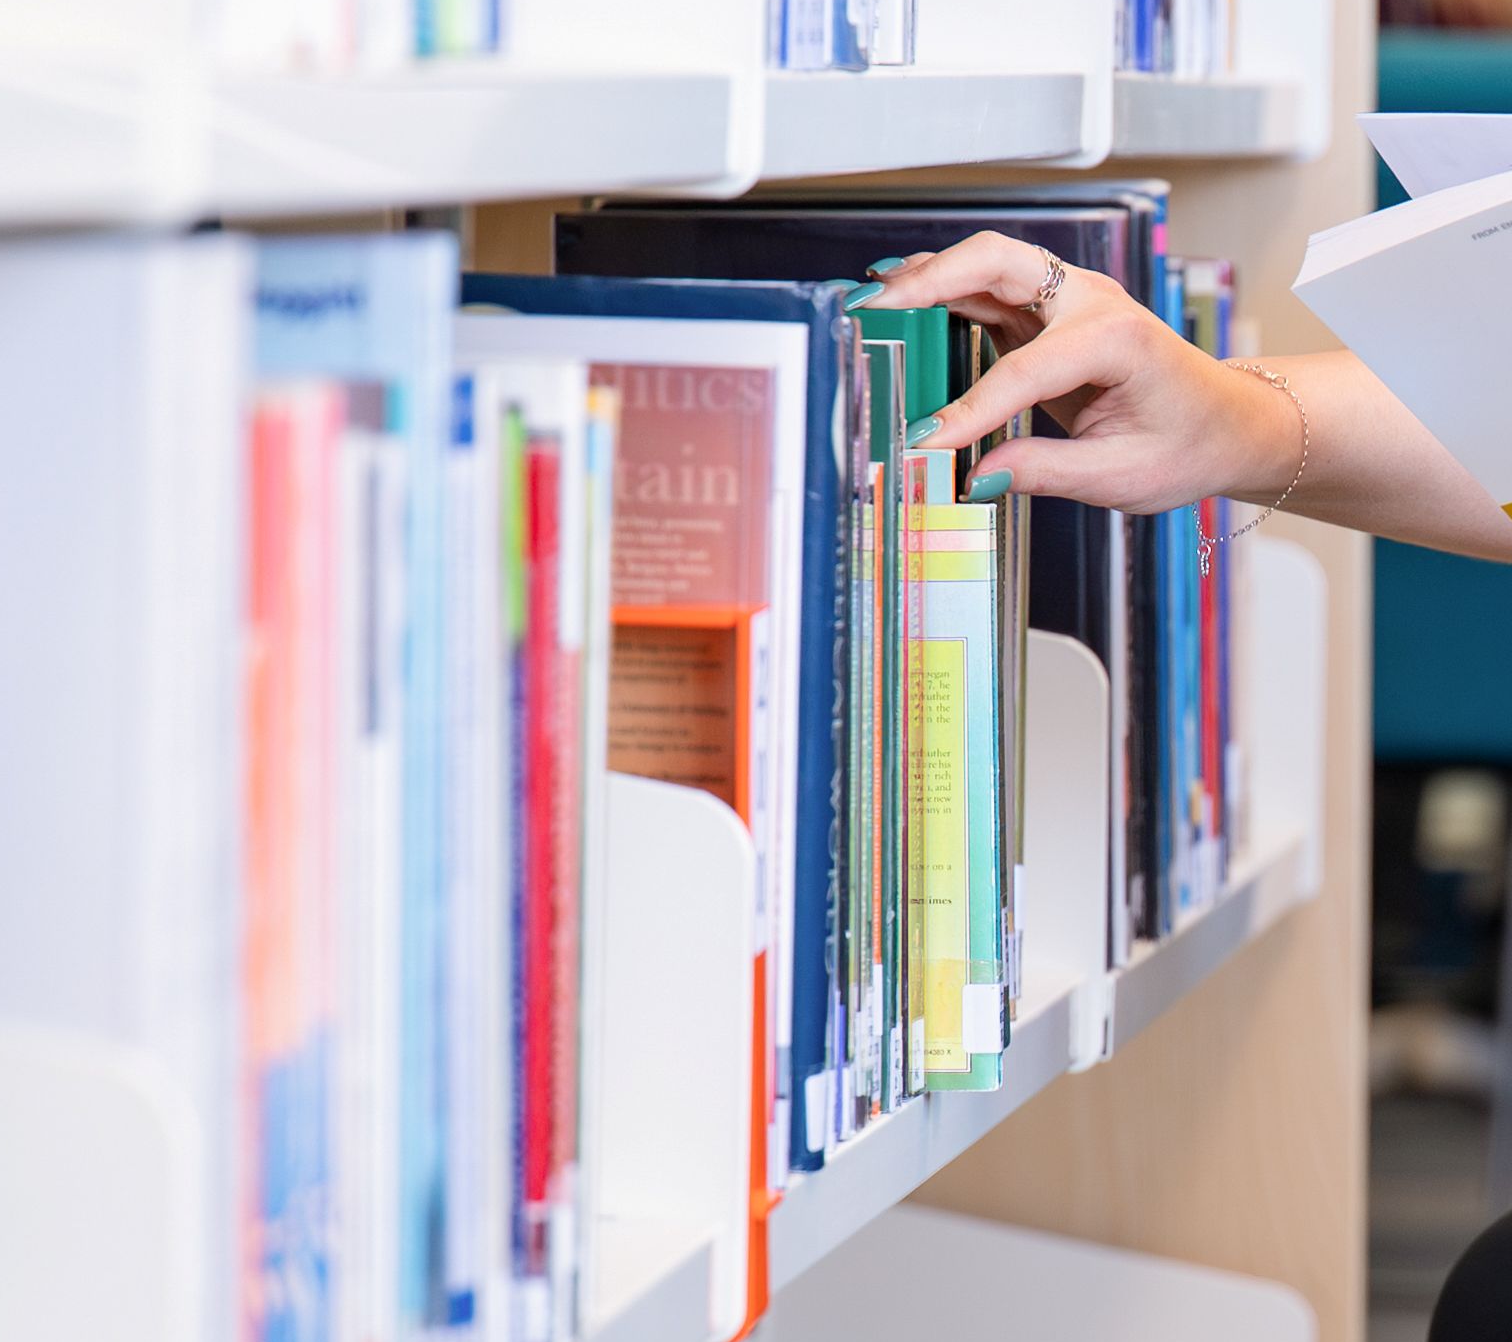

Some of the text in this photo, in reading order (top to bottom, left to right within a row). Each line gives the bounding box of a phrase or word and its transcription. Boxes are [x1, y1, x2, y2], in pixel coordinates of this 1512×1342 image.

[1471, 225, 1499, 242] FROM
[927, 671, 950, 680] egan
[939, 679, 951, 690] he
[926, 691, 950, 701] uther
[936, 703, 951, 712] the
[936, 714, 951, 724] the
[926, 748, 952, 758] uther
[934, 771, 952, 780] rich
[934, 783, 952, 792] and
[928, 895, 952, 905] imes
